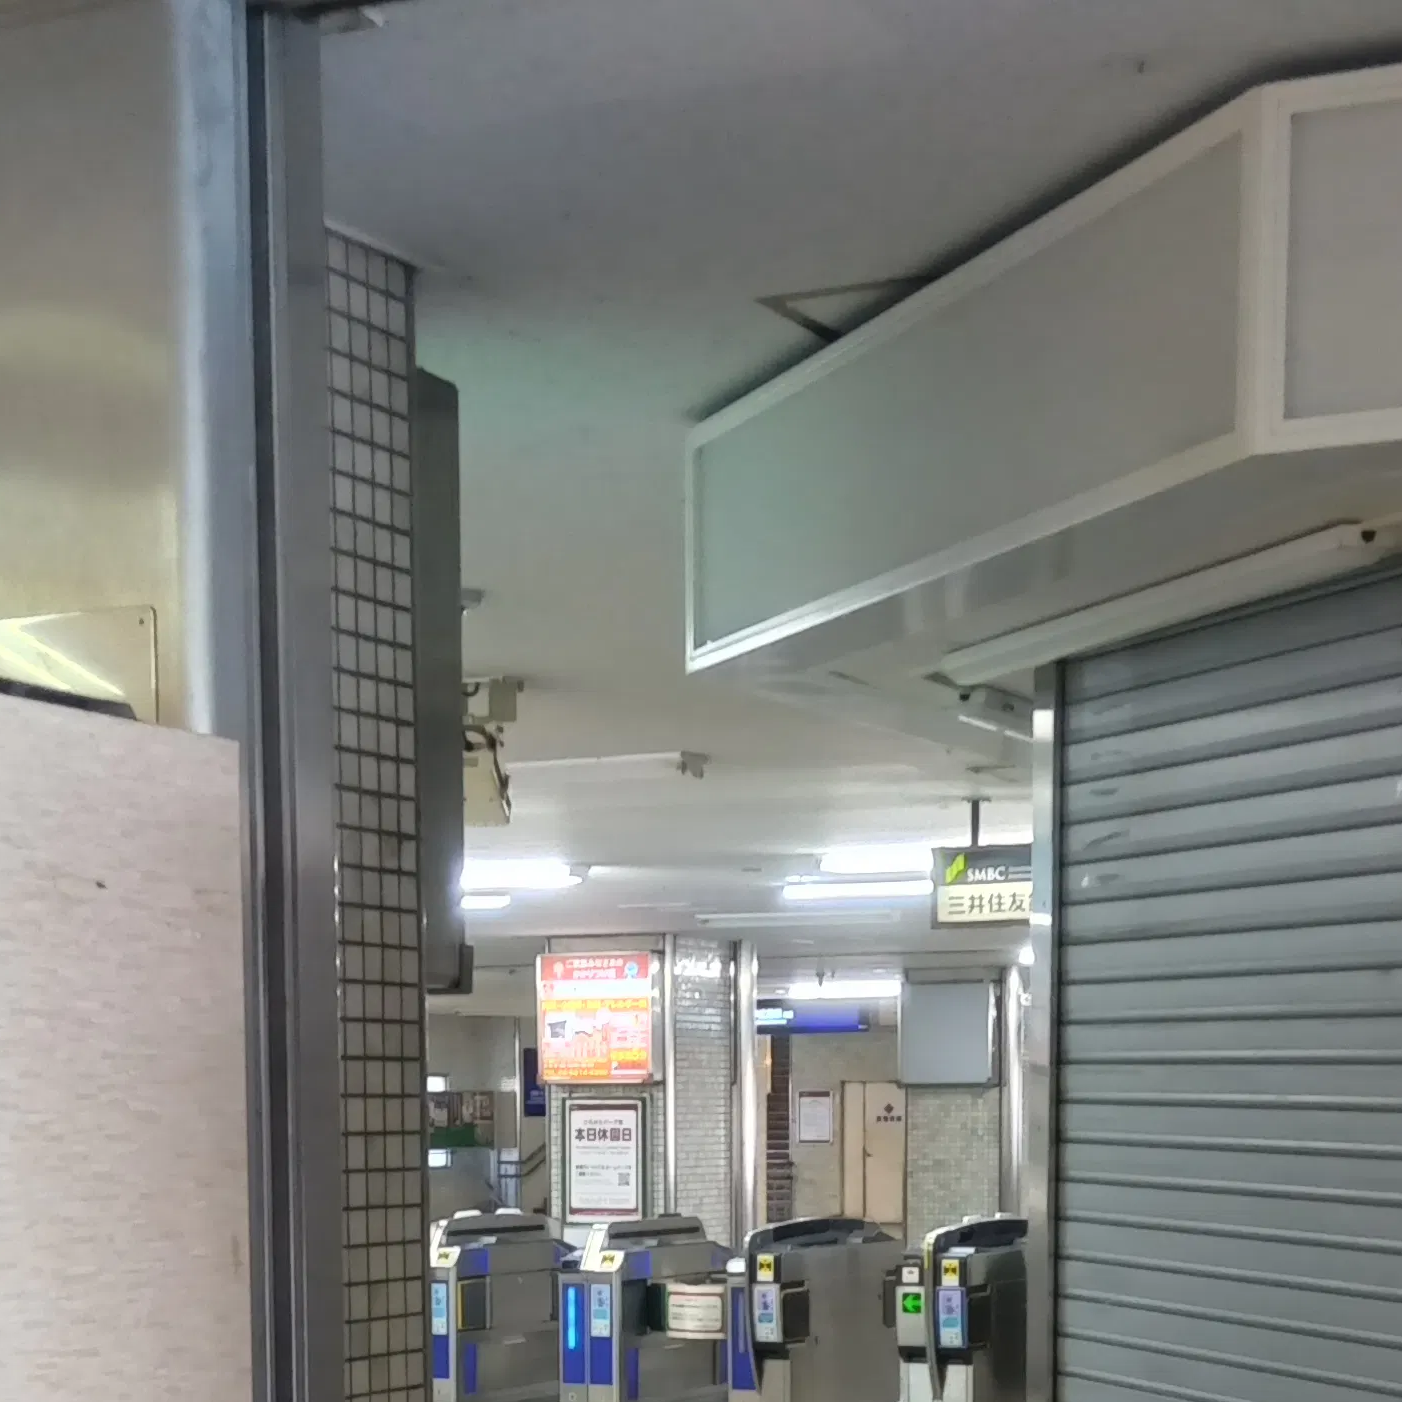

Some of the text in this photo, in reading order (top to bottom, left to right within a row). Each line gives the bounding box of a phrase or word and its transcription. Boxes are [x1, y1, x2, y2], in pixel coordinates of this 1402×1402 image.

[966, 866, 1006, 882] SMBC
[948, 892, 1033, 915] 三井住友
[575, 1127, 632, 1142] 本日休園日
